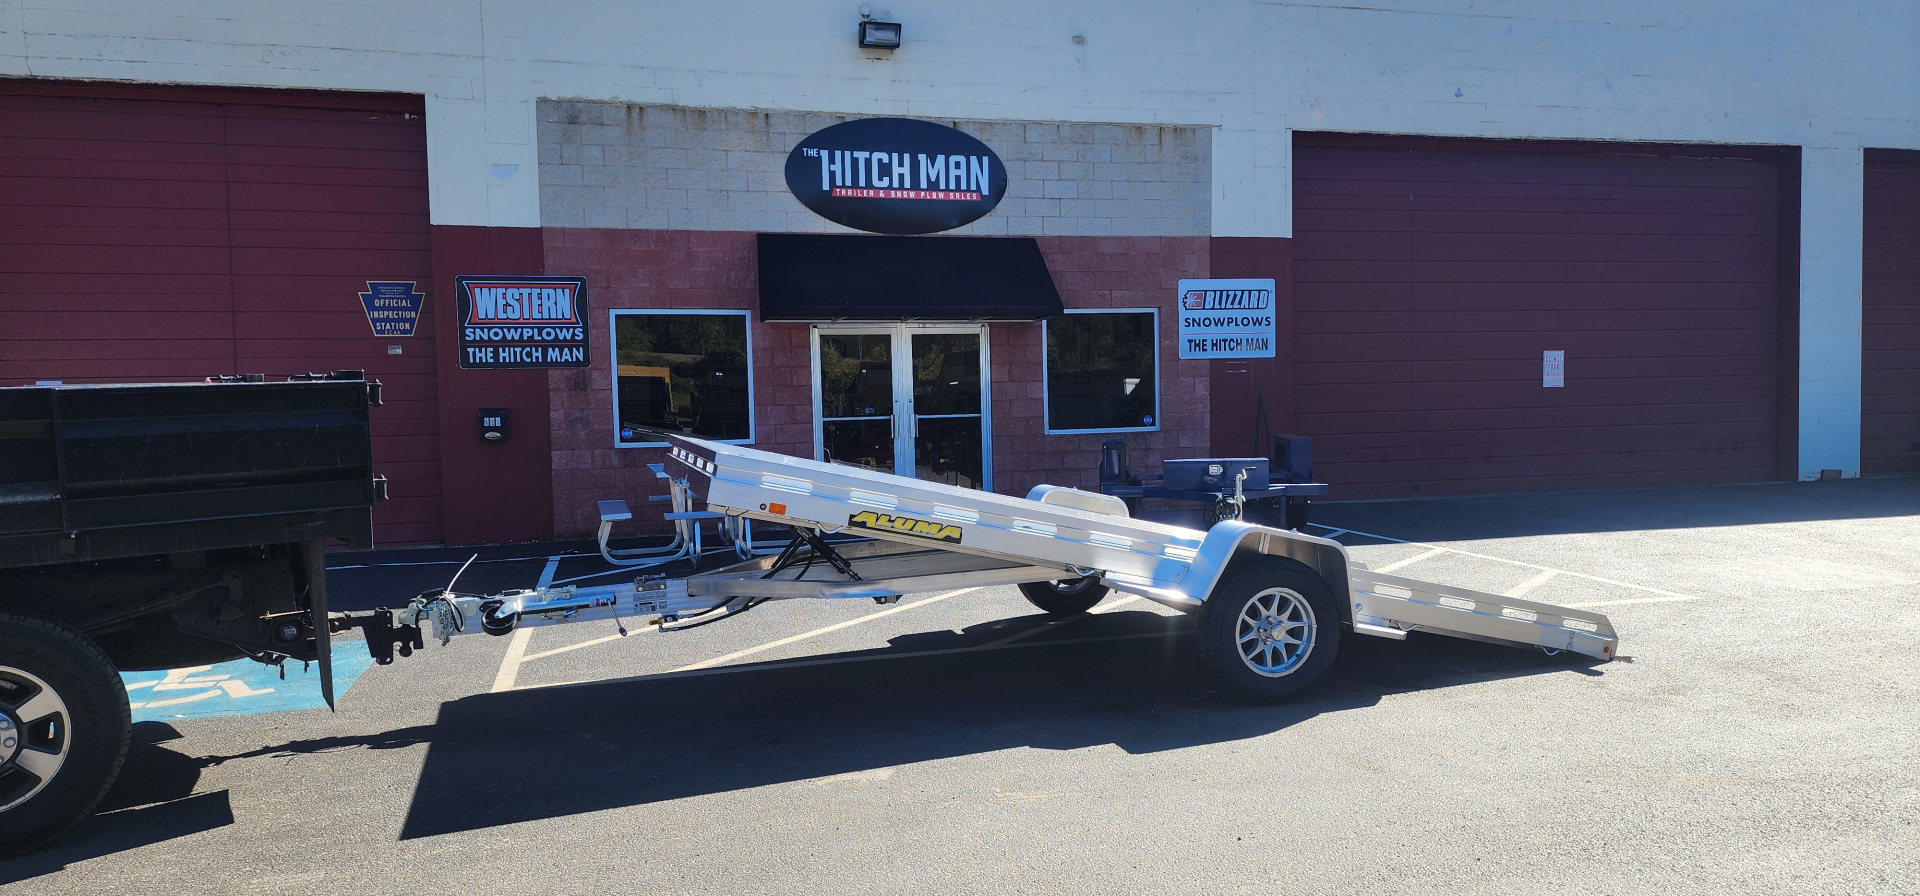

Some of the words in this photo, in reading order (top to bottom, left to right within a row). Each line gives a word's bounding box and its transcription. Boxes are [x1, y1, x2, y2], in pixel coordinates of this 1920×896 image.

[802, 147, 819, 157] THE
[819, 149, 911, 191] HITCH
[917, 153, 990, 196] MAN
[836, 188, 874, 197] TRAILER
[879, 190, 885, 198] &
[890, 190, 916, 198] SNOW
[920, 191, 945, 199] PLOW
[949, 191, 977, 200] SALES
[473, 287, 572, 320] WESTERN
[1204, 290, 1269, 309] BLIZZARD
[1184, 316, 1271, 328] SNOWPLOWS
[465, 328, 584, 341] SNOWPLOWS
[1187, 338, 1208, 352] THE
[1211, 338, 1243, 352] HITCH
[1245, 337, 1269, 351] MAN
[467, 347, 494, 363] THE
[499, 347, 542, 363] HITCH
[547, 347, 584, 362] MAN
[850, 510, 962, 540] ALUMA
